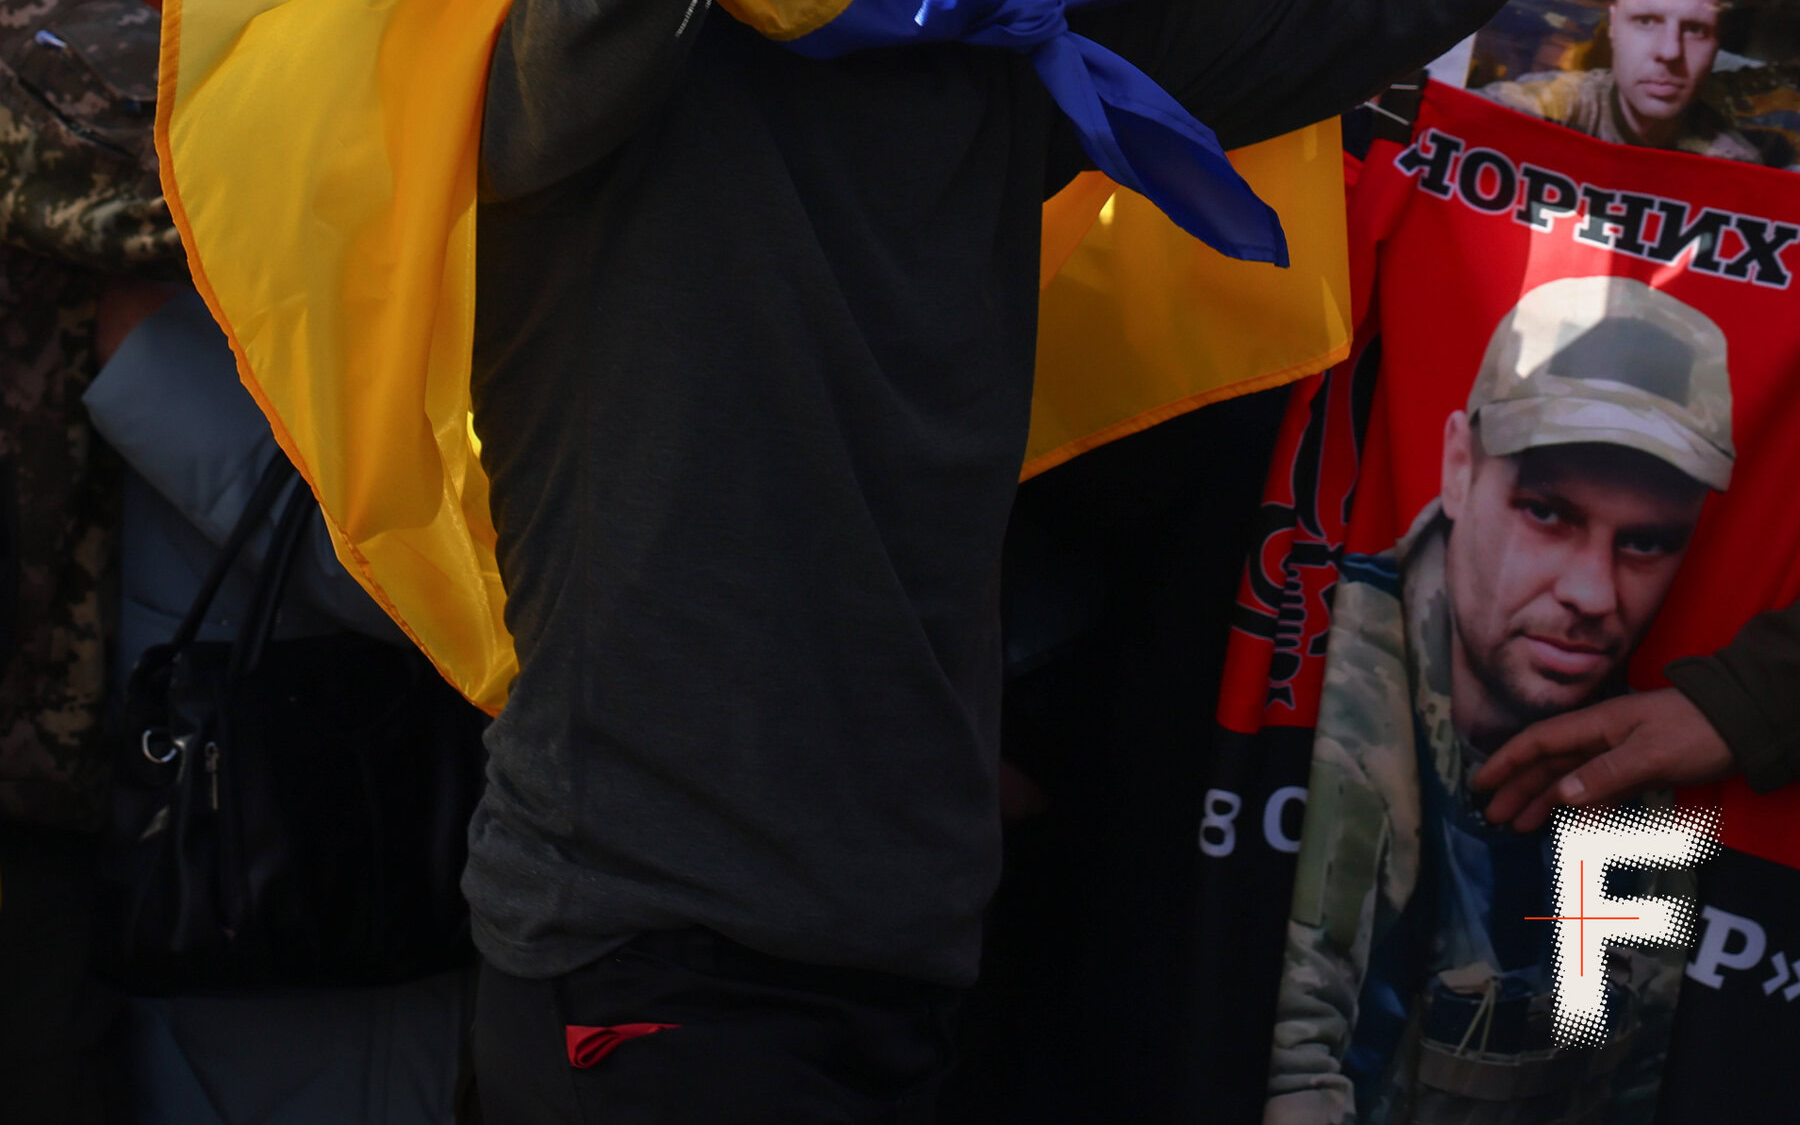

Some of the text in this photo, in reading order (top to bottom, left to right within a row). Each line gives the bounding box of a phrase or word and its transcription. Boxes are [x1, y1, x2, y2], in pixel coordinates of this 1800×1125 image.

[1394, 128, 1800, 289] ЧОРНИХ
[1198, 788, 1243, 858] 8
[1685, 904, 1800, 1003] Р»
